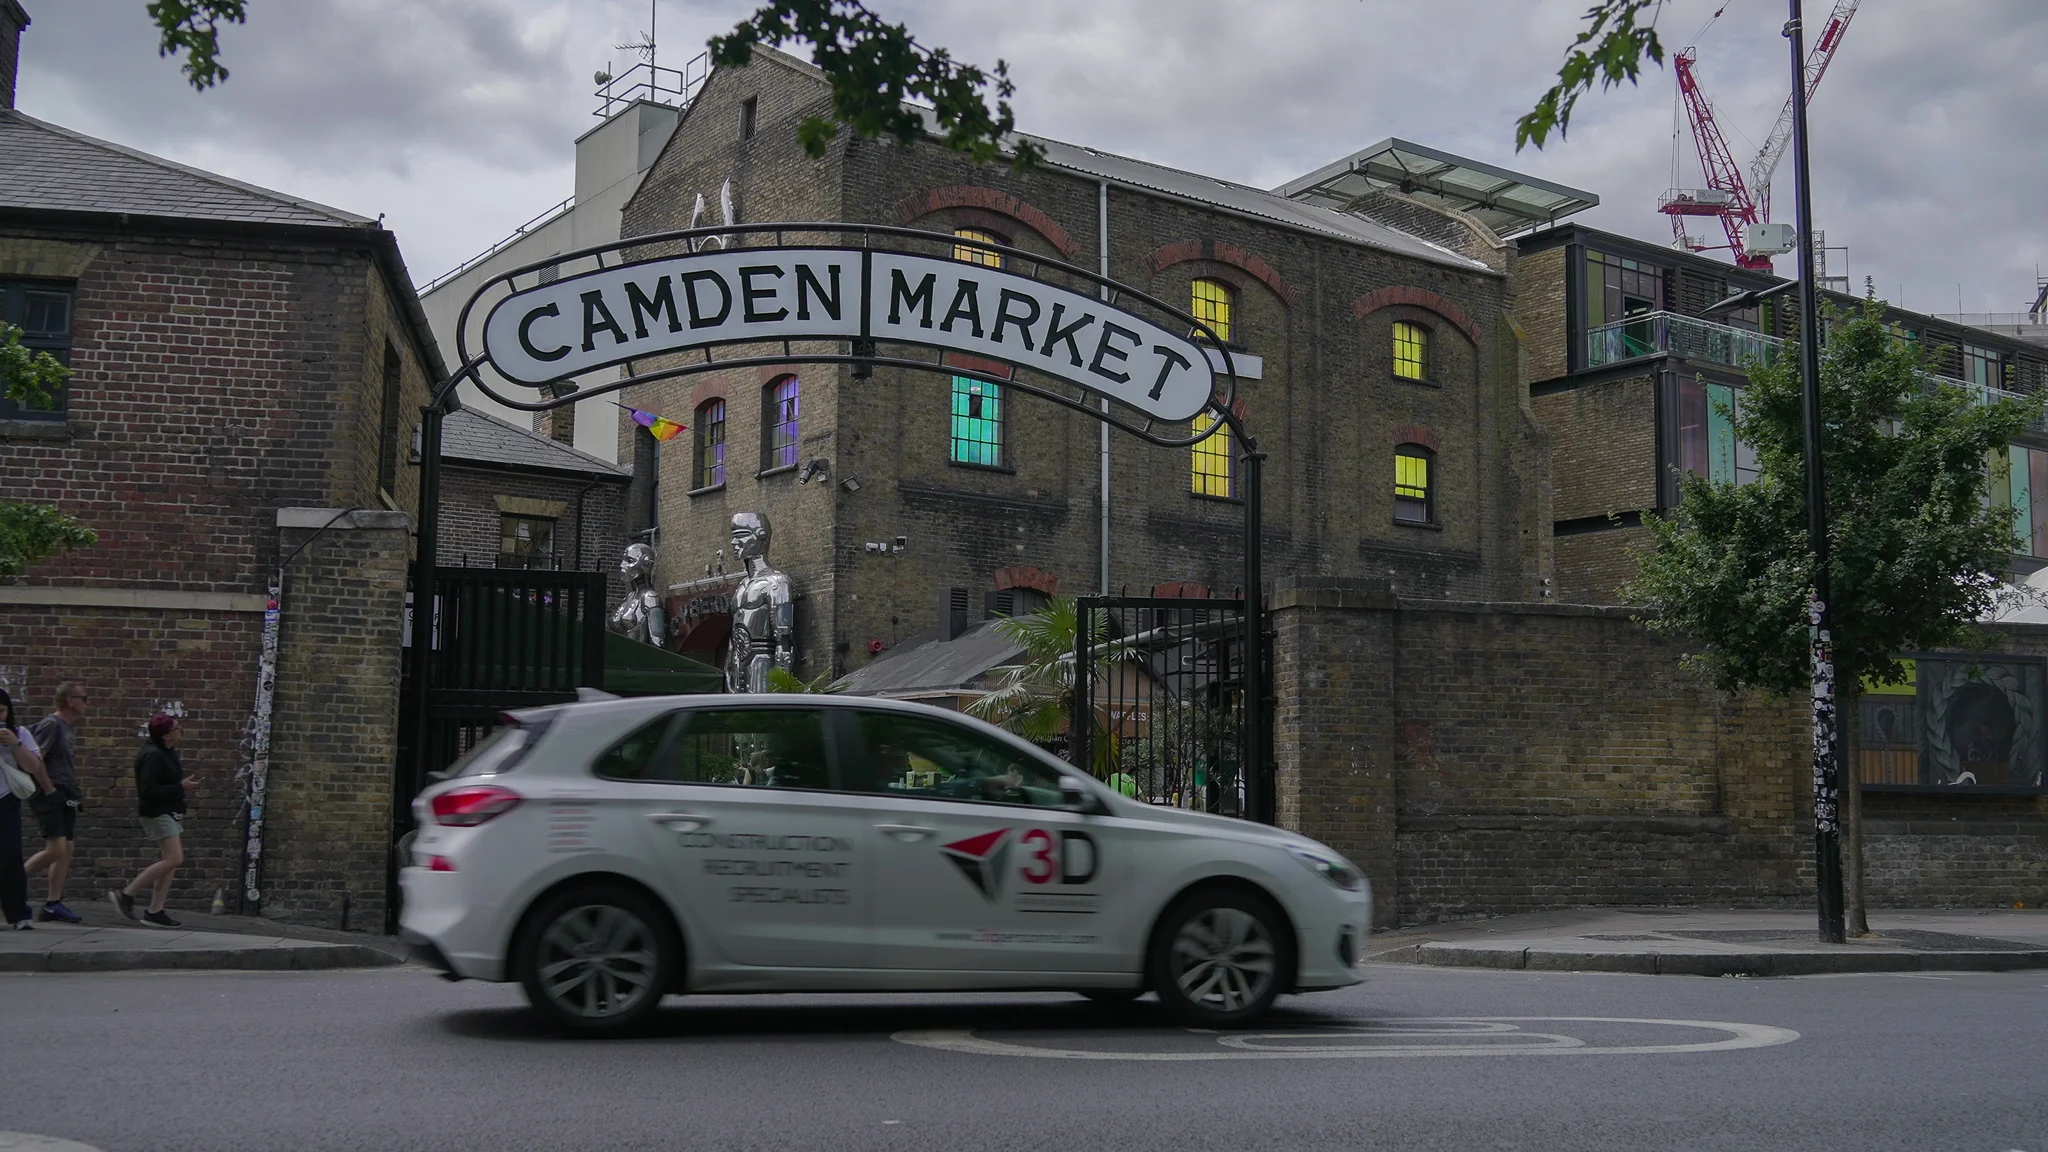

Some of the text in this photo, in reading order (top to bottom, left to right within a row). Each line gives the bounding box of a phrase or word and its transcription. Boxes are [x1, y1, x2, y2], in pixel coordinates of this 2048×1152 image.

[517, 264, 1192, 401] CAMDEN MARKET
[677, 832, 854, 852] CONSTRUCTION
[1019, 829, 1101, 885] 3D
[702, 859, 852, 878] RECRUITMENT
[728, 886, 852, 905] SPECIALISTS
